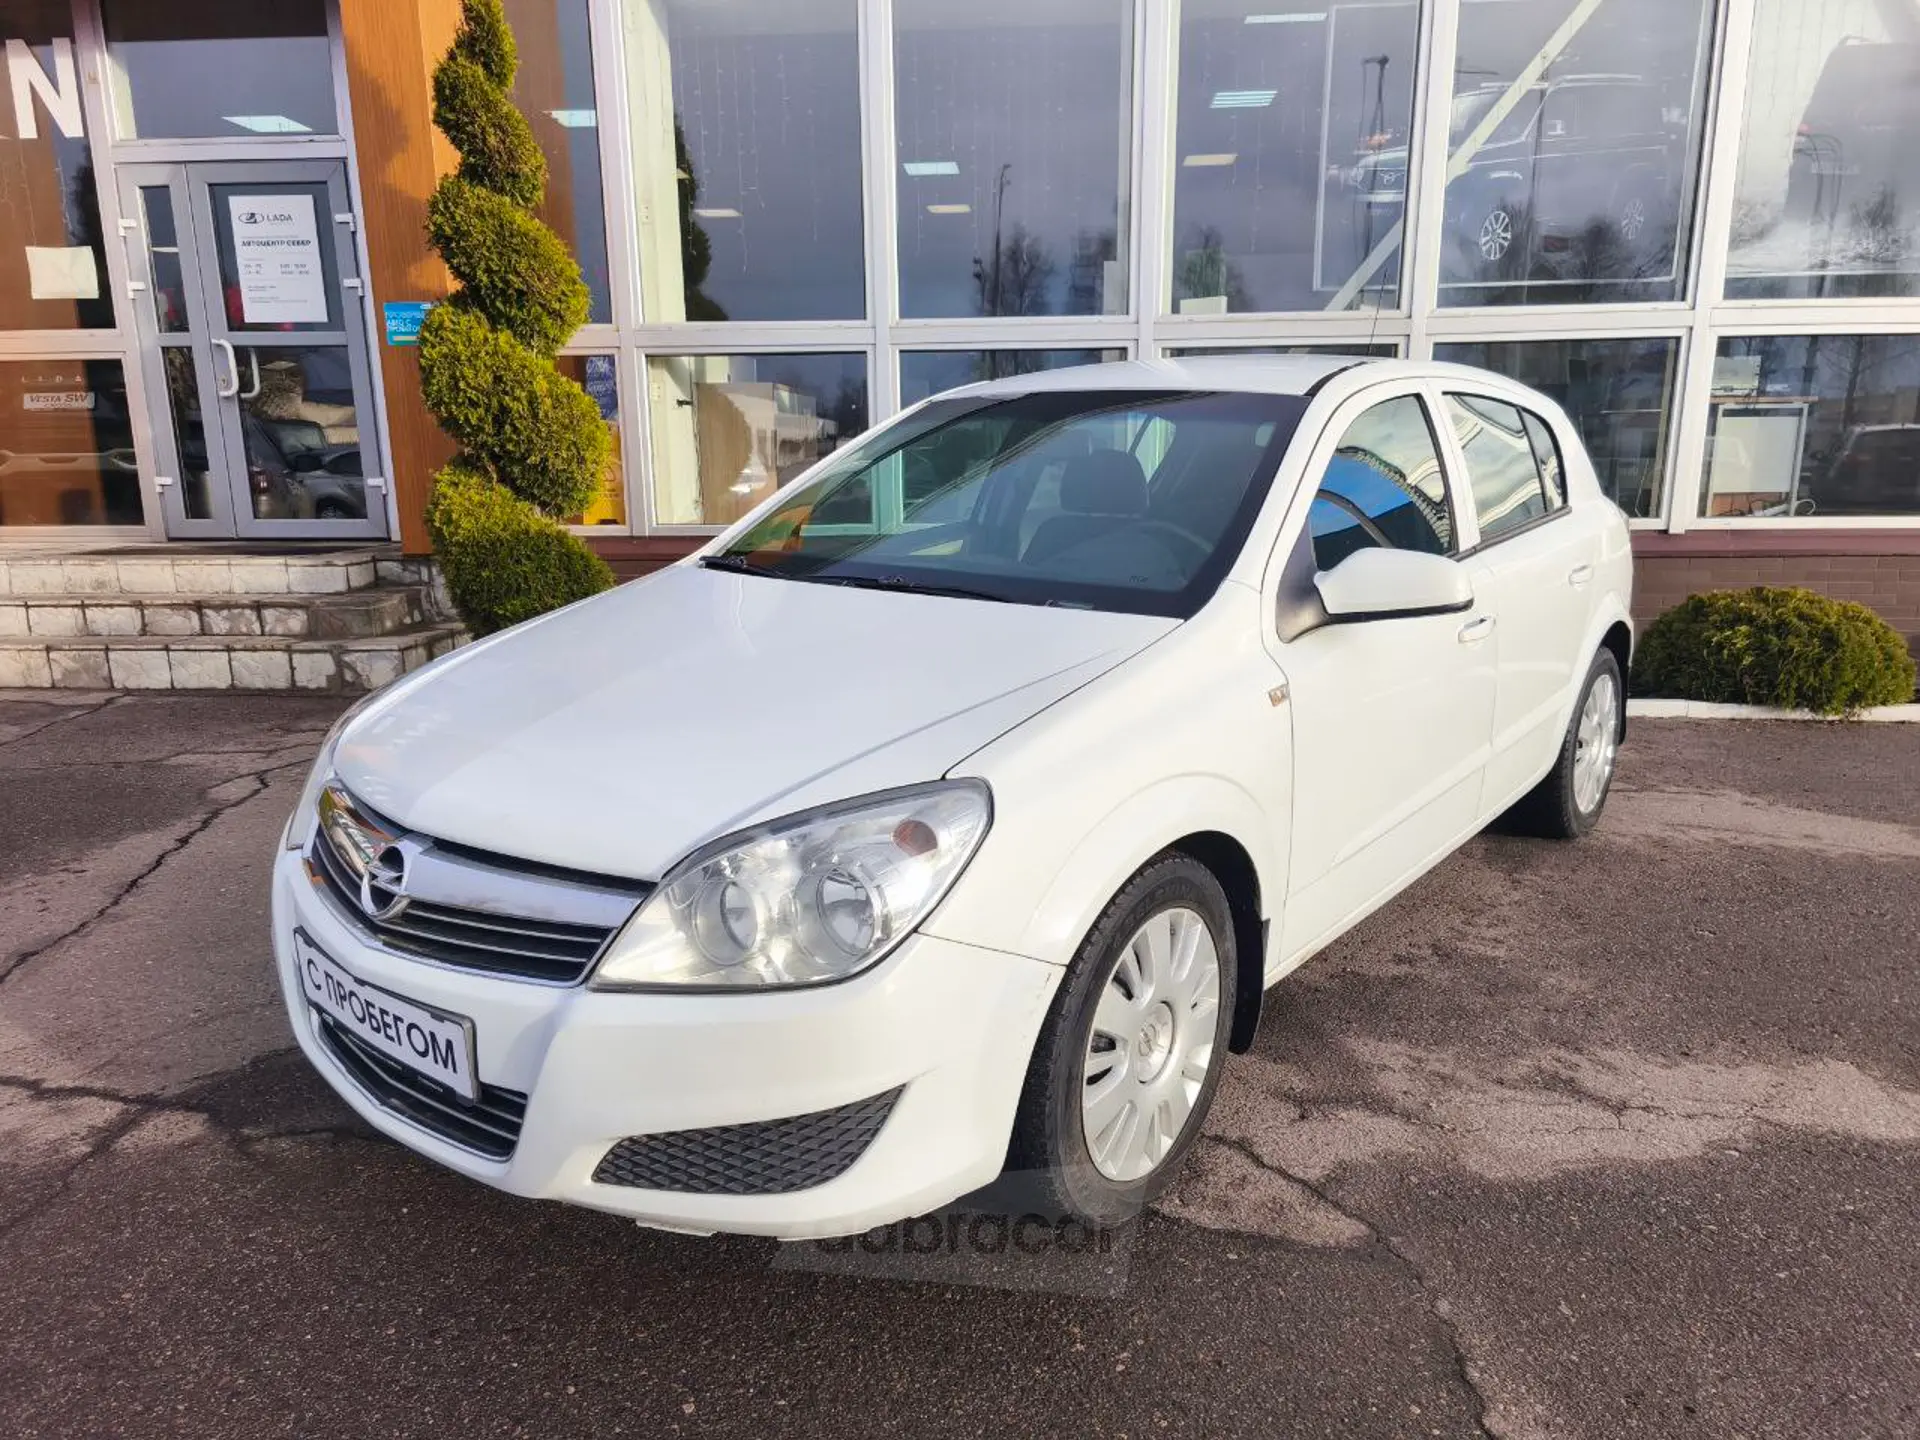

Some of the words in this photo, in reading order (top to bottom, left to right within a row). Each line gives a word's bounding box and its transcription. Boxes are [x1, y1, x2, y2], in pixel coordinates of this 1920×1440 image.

[5, 37, 84, 138] N
[266, 213, 293, 222] LADA
[241, 239, 285, 247] АВТОЦЕНТР
[286, 239, 312, 247] СЕВЕР
[30, 394, 62, 403] VESTA
[64, 393, 88, 403] SW
[307, 958, 322, 991] С
[324, 969, 457, 1073] ПРОБЕГОМ
